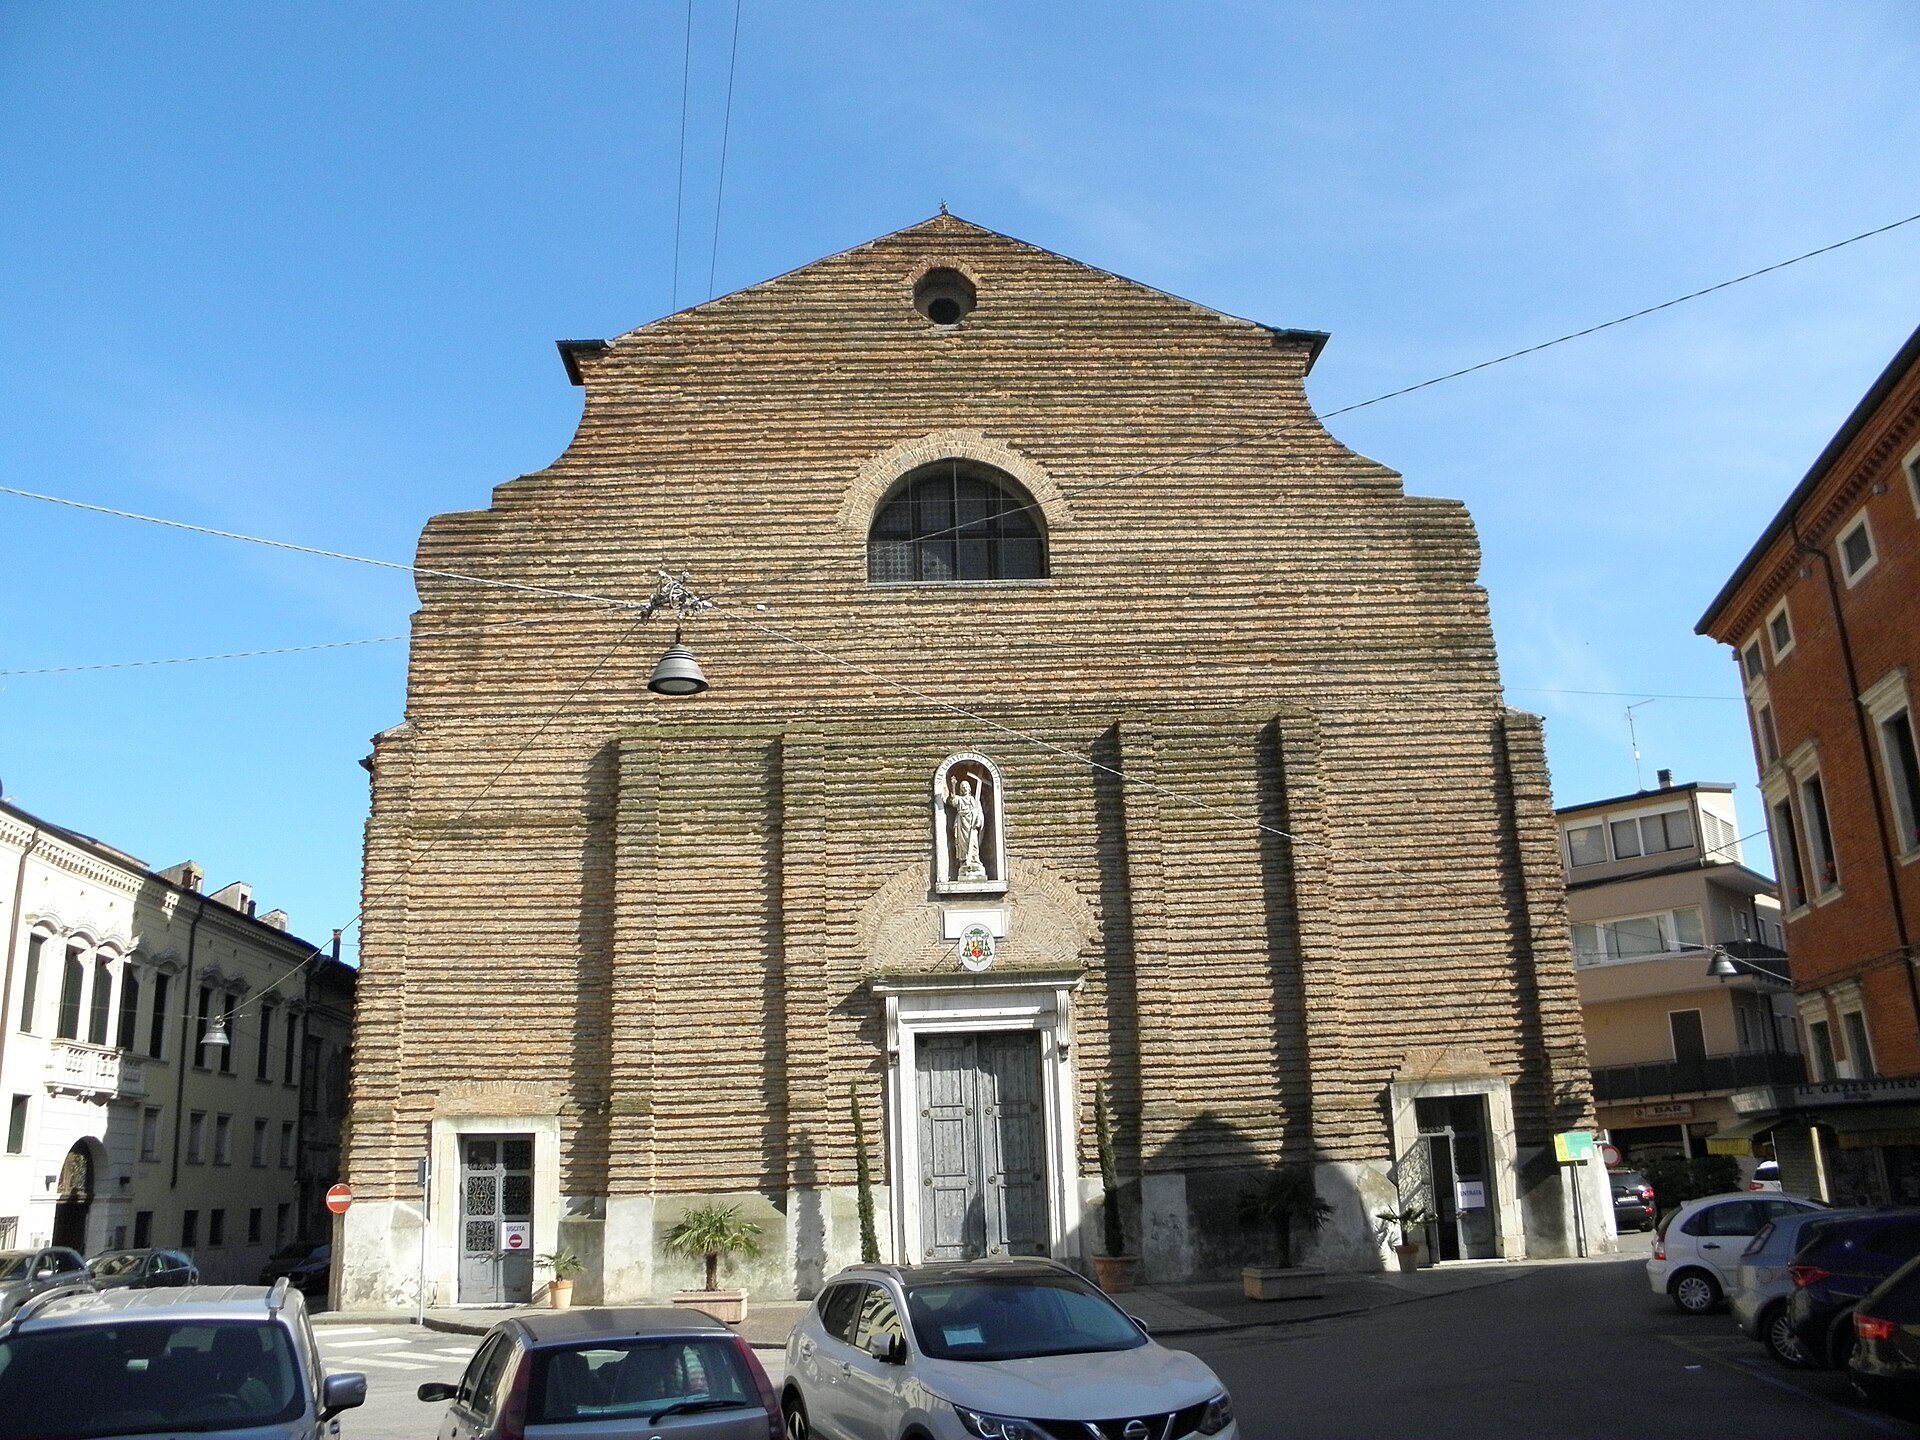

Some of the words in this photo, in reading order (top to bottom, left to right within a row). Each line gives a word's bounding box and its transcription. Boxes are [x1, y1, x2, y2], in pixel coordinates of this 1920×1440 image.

[1799, 1085, 1813, 1095] IL
[1821, 1080, 1918, 1094] GAZZETTINO
[1655, 1104, 1682, 1114] BAR
